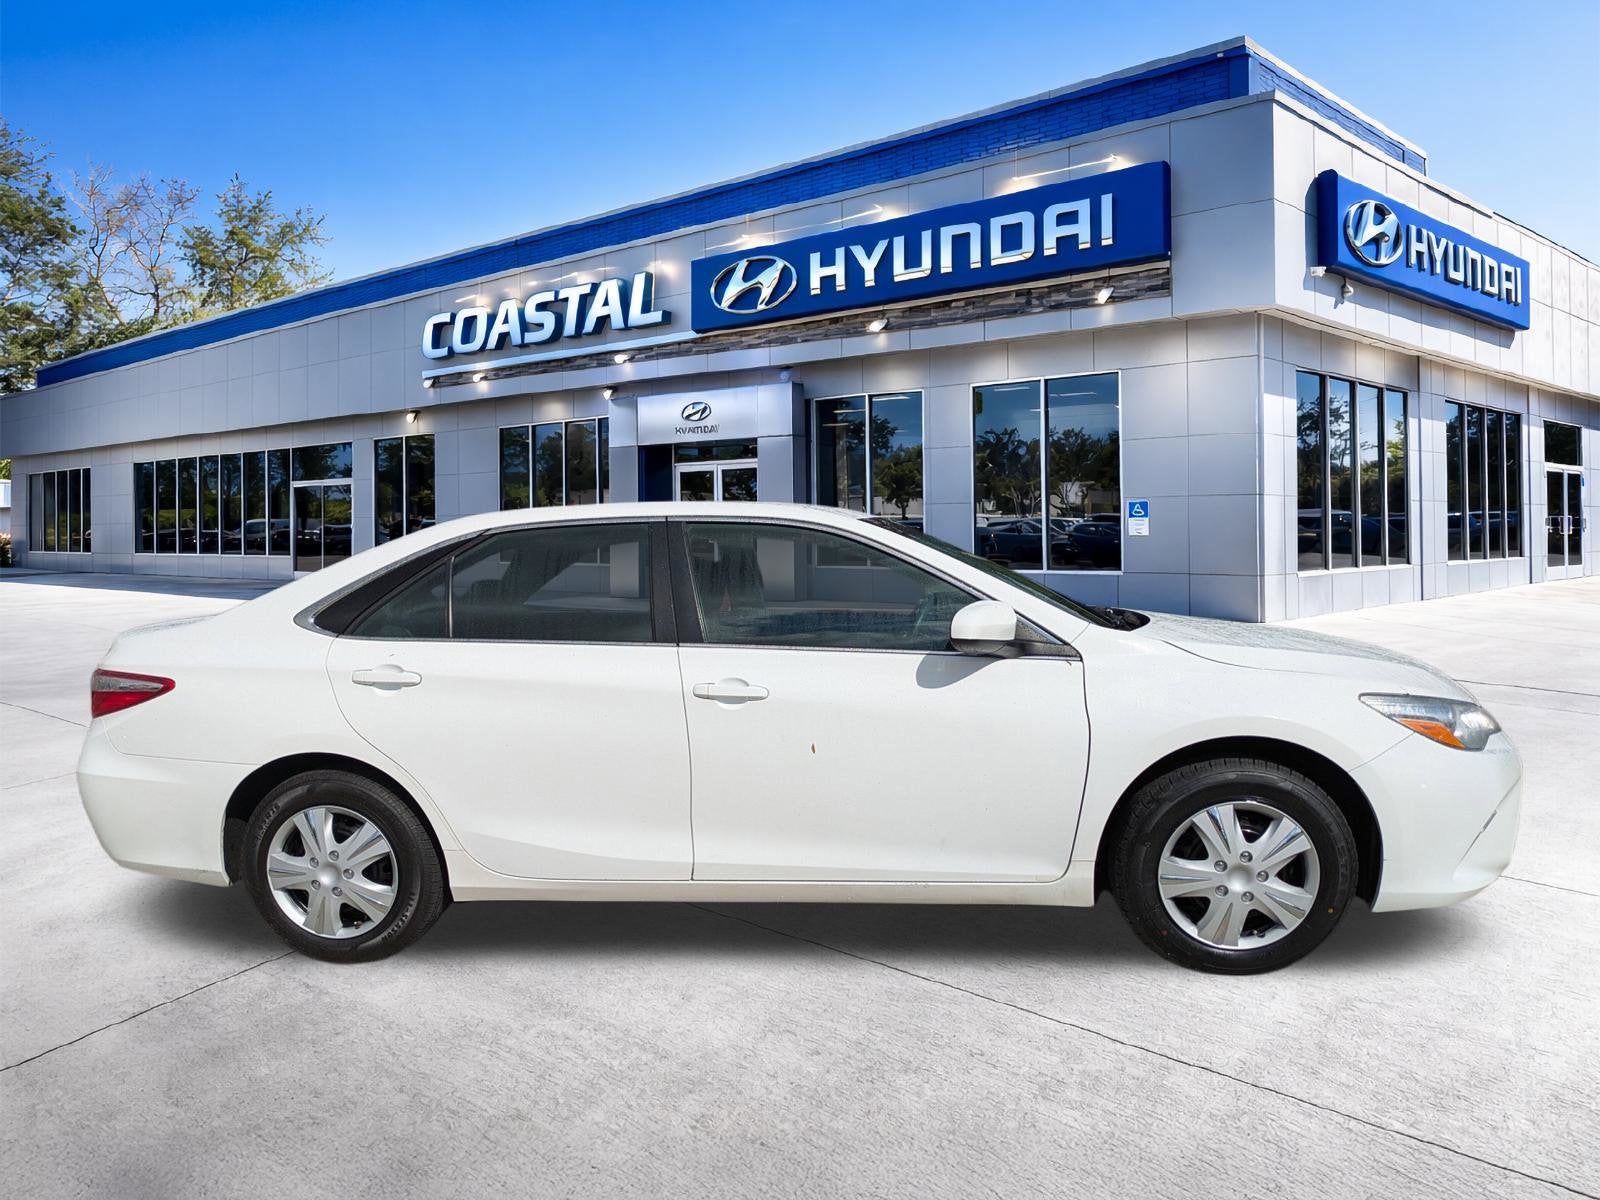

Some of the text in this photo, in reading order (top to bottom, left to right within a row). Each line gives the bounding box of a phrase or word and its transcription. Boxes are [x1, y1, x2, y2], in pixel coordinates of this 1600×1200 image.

[809, 192, 1114, 296] HYUNDAI
[1406, 223, 1522, 306] HYUNDAI
[422, 271, 669, 360] COASTAL
